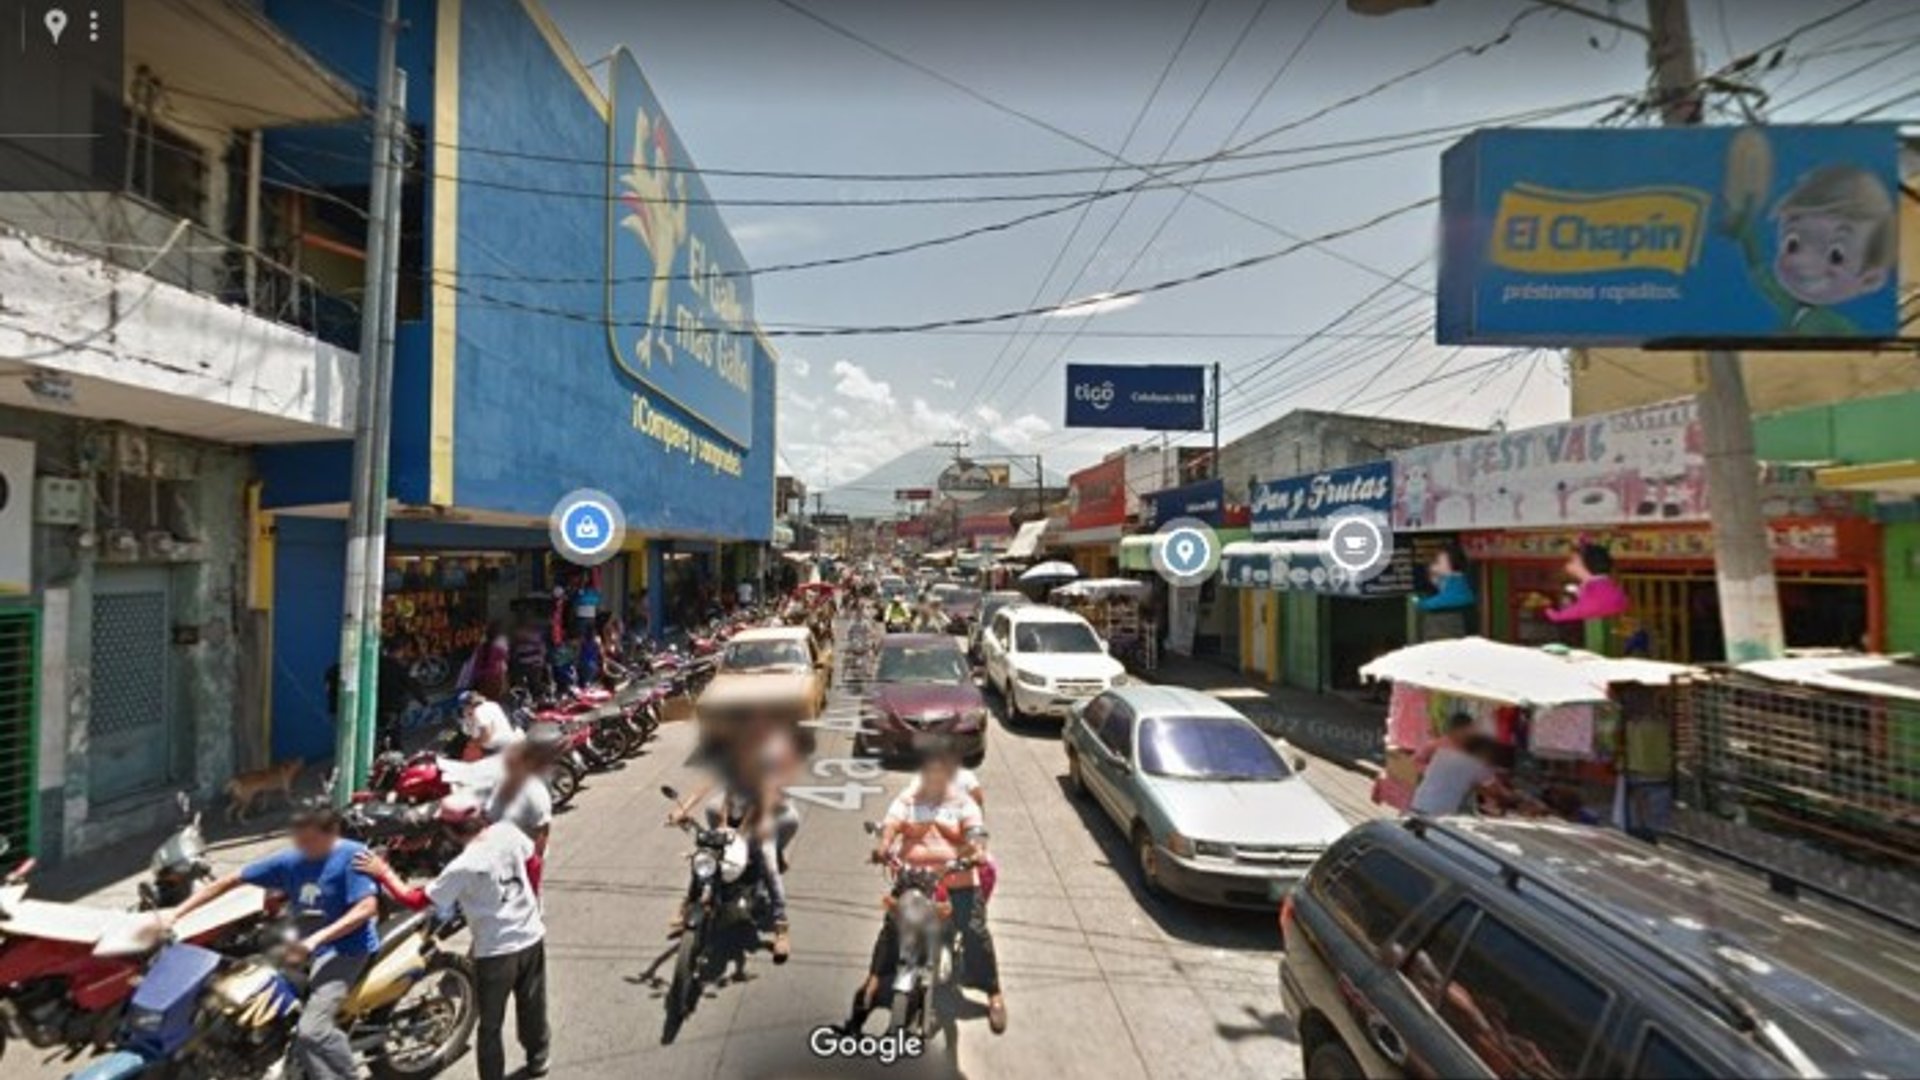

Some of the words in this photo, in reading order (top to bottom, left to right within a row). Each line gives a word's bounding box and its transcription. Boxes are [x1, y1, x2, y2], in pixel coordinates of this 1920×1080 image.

[1504, 214, 1539, 252] El
[1551, 210, 1682, 261] Chapín
[1502, 282, 1594, 304] préstamos
[1252, 484, 1289, 513] Pan
[1286, 486, 1306, 520] y
[1308, 474, 1389, 511] Frutas
